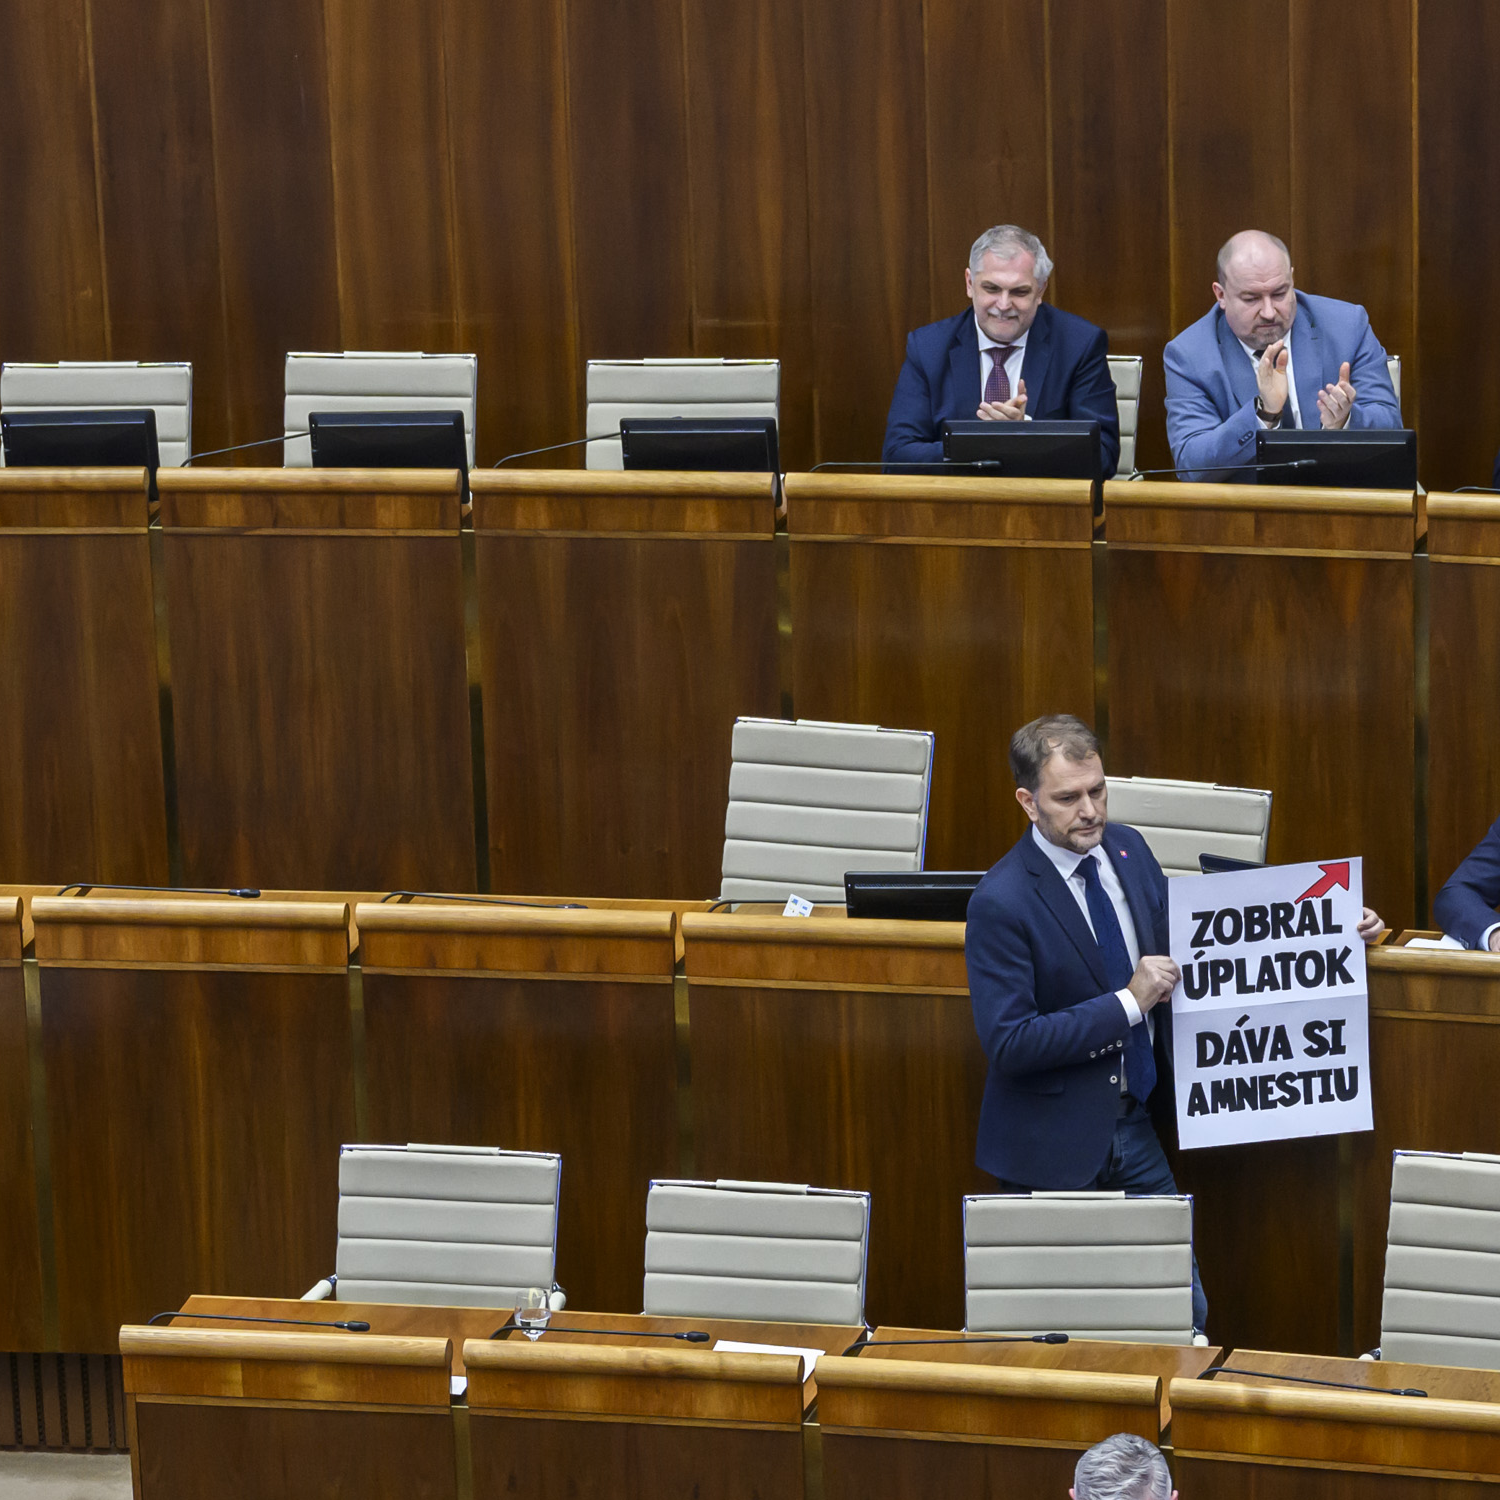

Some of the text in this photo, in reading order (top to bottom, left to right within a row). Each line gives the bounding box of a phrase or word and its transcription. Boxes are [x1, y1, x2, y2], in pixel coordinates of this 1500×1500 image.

[1190, 898, 1343, 948] ZOBRAL
[1181, 946, 1355, 1000] ÚPLATOK
[1195, 1014, 1346, 1068] DÁVA SI
[1187, 1066, 1358, 1117] AMNESTIU
